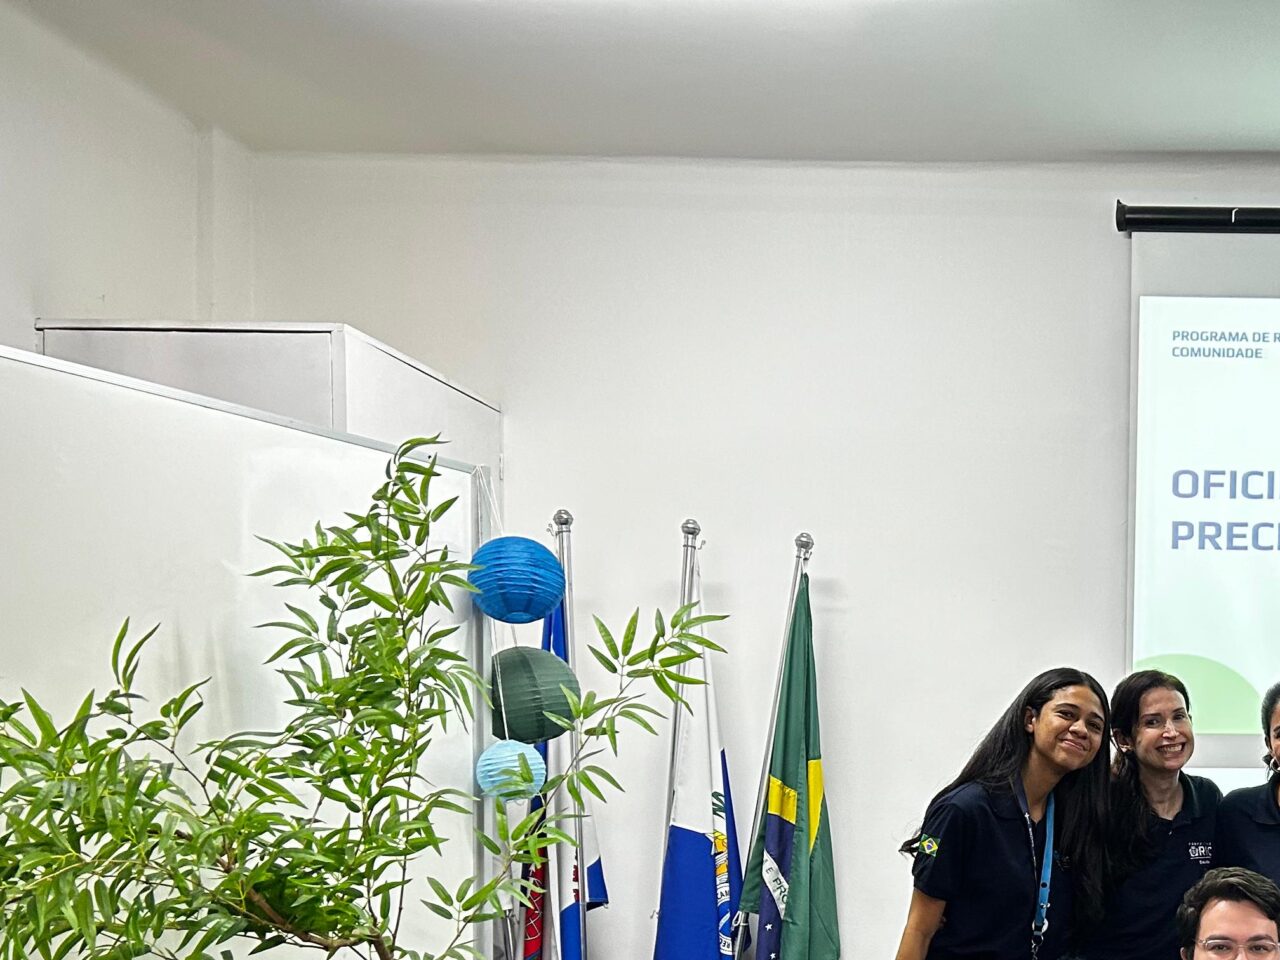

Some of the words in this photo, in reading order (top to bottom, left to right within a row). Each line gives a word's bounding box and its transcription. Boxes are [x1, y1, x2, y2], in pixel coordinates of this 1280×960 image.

[1172, 330, 1248, 342] PROGRAMA
[1252, 331, 1270, 343] DE
[1172, 346, 1263, 359] COMUNIDADE
